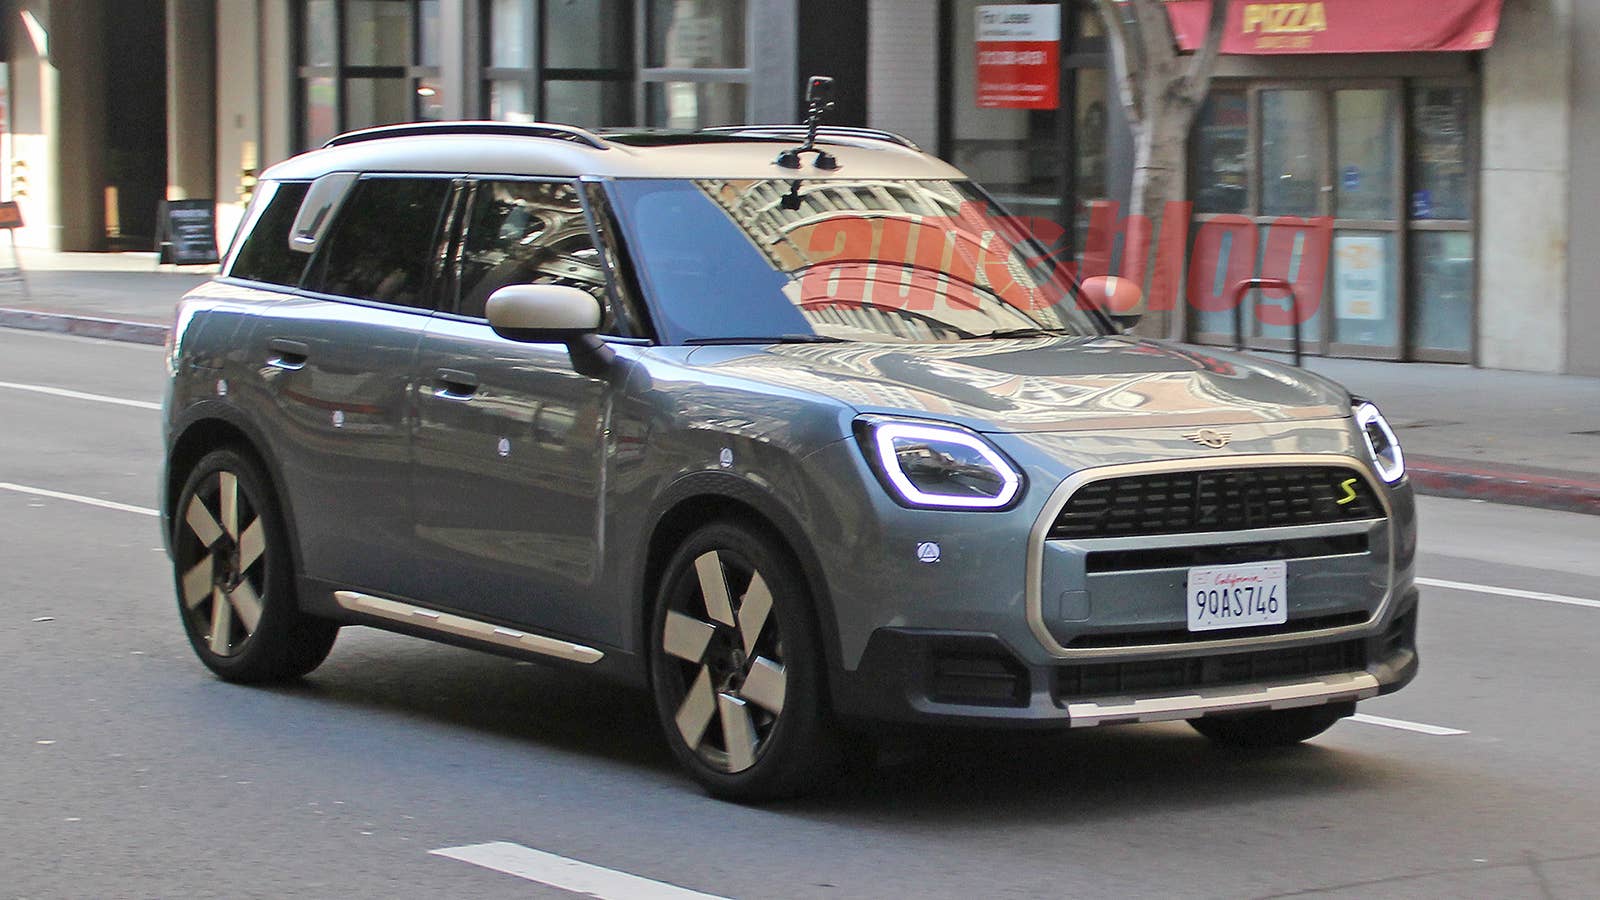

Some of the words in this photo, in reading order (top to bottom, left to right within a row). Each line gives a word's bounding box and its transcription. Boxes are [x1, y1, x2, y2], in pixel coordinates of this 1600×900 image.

[1243, 2, 1327, 33] PIZZA
[1336, 478, 1358, 505] S
[1214, 573, 1263, 588] California
